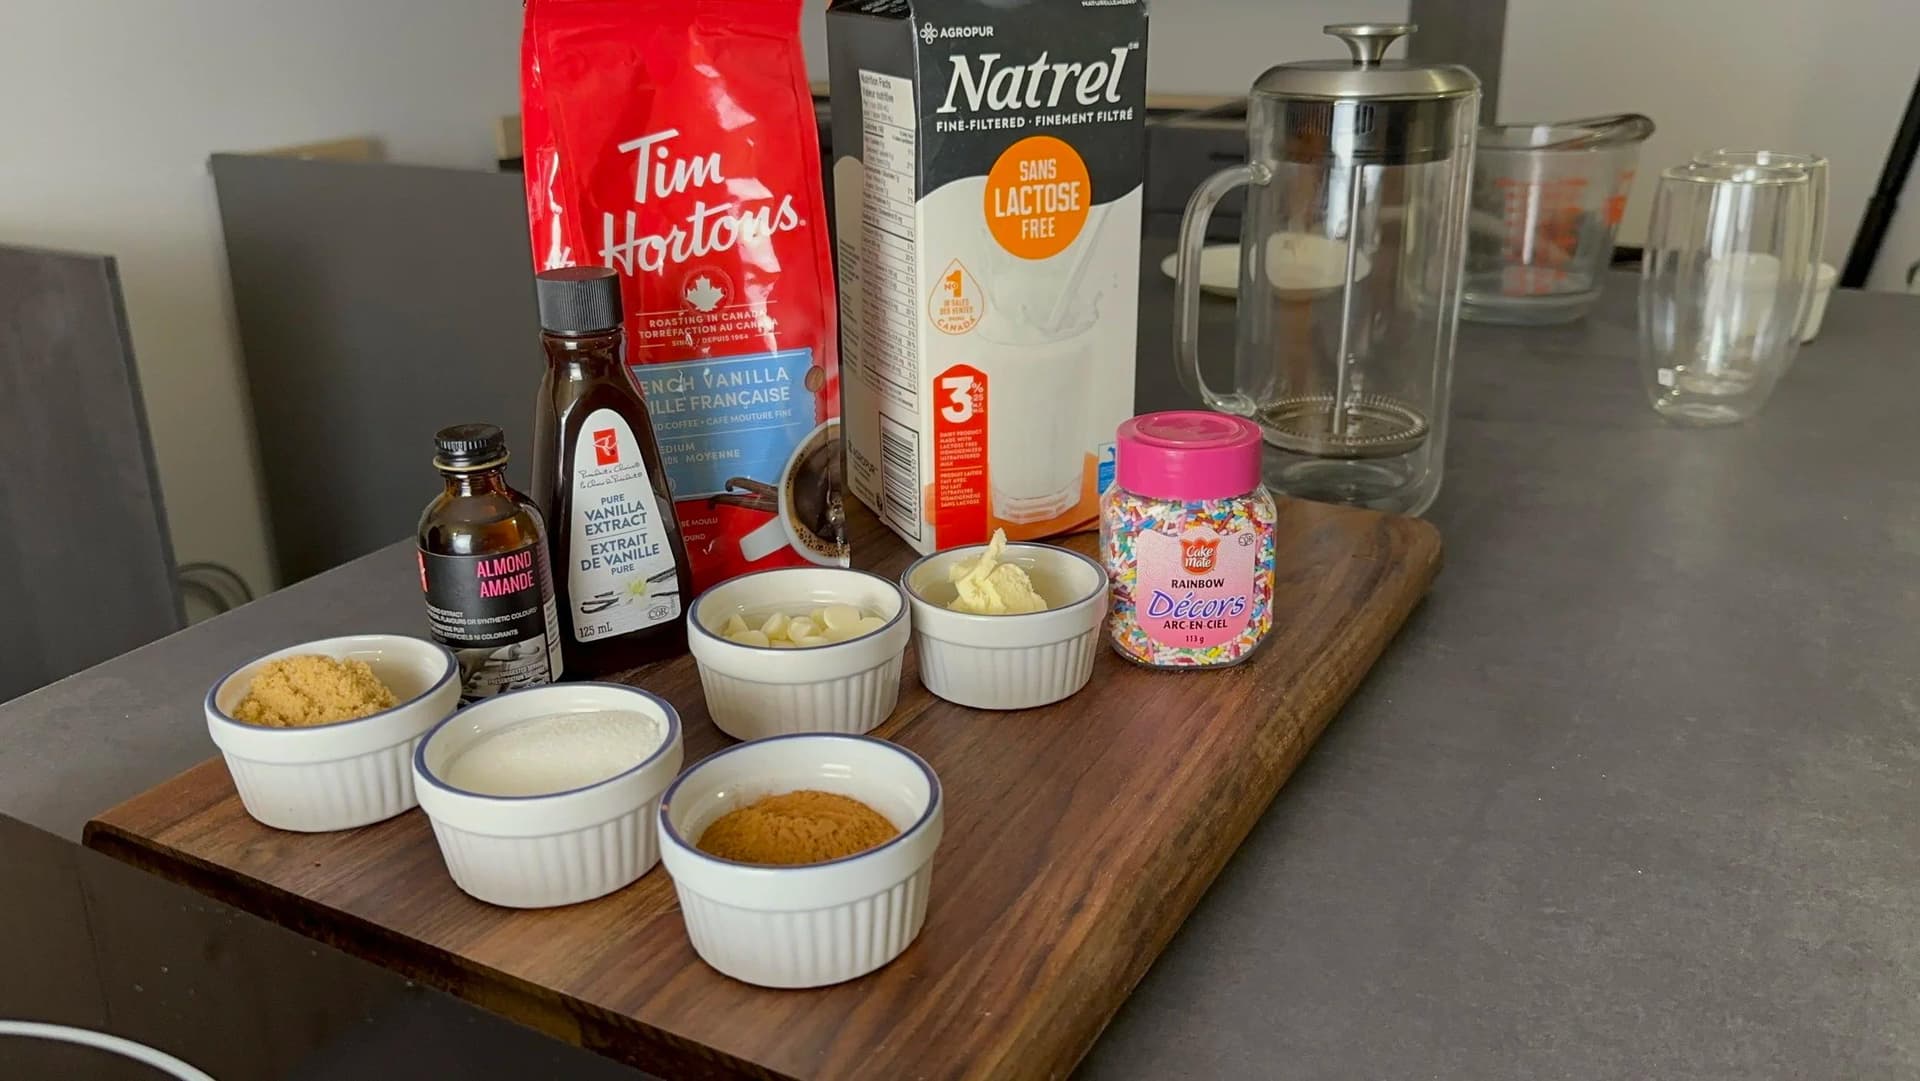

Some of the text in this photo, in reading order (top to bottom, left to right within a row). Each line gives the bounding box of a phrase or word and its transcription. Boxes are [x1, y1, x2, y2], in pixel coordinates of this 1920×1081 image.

[940, 25, 994, 38] AGROPUR
[936, 47, 1129, 114] Natrel
[936, 107, 1133, 132] FINE-FILTERED FINEMENT FILTRÉ
[617, 128, 725, 204] Tim
[1019, 159, 1057, 182] SANS
[994, 181, 1080, 218] LACTOSE
[598, 194, 799, 277] Hortons
[1021, 217, 1056, 240] FREE
[649, 310, 767, 328] ROASTING IN CANADA
[639, 325, 717, 339] TORRÉFACTION
[719, 323, 733, 332] AU
[702, 335, 730, 344] DEPUIS
[731, 333, 749, 341] 1964
[642, 366, 790, 396] ENCH VANILLA
[650, 386, 790, 416] ILLE FRANÇAISE
[941, 375, 975, 423] 3
[666, 419, 699, 431] COFFEE
[730, 412, 774, 423] MOUTURE
[775, 409, 793, 418] FINE
[660, 443, 696, 455] EDIUM
[686, 449, 741, 463] MOYENNE
[601, 494, 625, 505] PURE
[584, 500, 645, 522] VANILLA
[585, 512, 648, 536] EXTRACT
[591, 533, 648, 556] EXTRAIT
[684, 533, 706, 543] OUND
[581, 543, 660, 572] DE VANILLE
[1186, 545, 1214, 558] Cake
[477, 550, 532, 578] ALMOND
[611, 564, 635, 575] PURE
[479, 570, 535, 598] AMANDE
[1171, 578, 1225, 589] RAINBOW
[1148, 589, 1246, 619] Décors
[477, 614, 511, 625] SYNTHETIC
[578, 622, 613, 639] 125 mL
[481, 628, 519, 641] COLORANTS
[1185, 634, 1205, 645] 113 g
